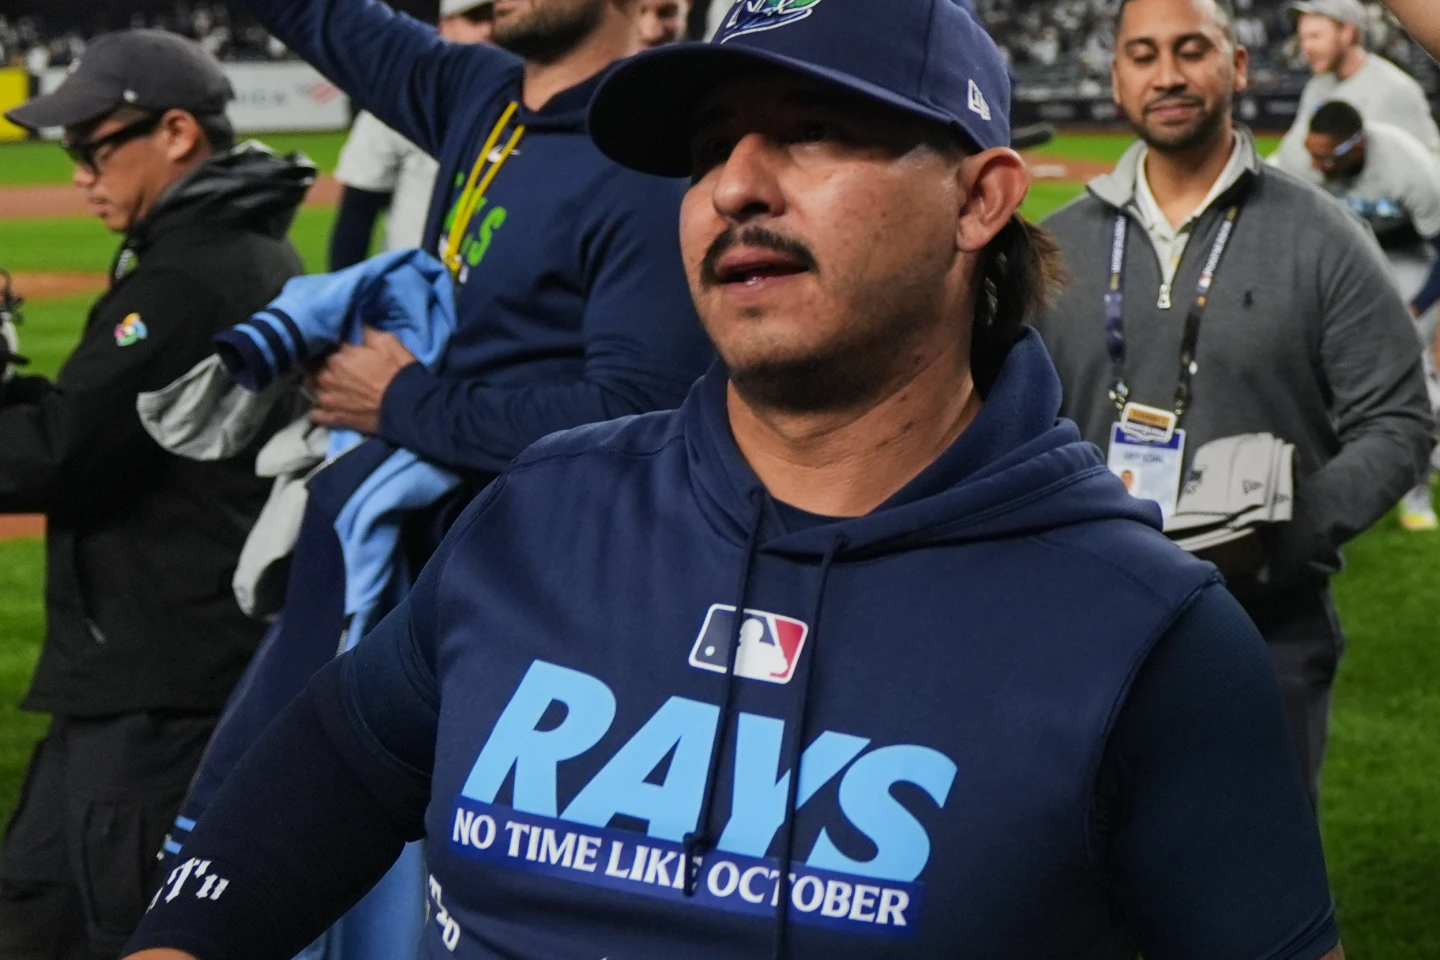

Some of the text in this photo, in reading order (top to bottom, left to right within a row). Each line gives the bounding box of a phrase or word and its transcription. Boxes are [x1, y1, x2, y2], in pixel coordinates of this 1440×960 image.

[461, 659, 957, 881] RAYS
[453, 807, 910, 927] NO TIME LIKE OCTOBER
